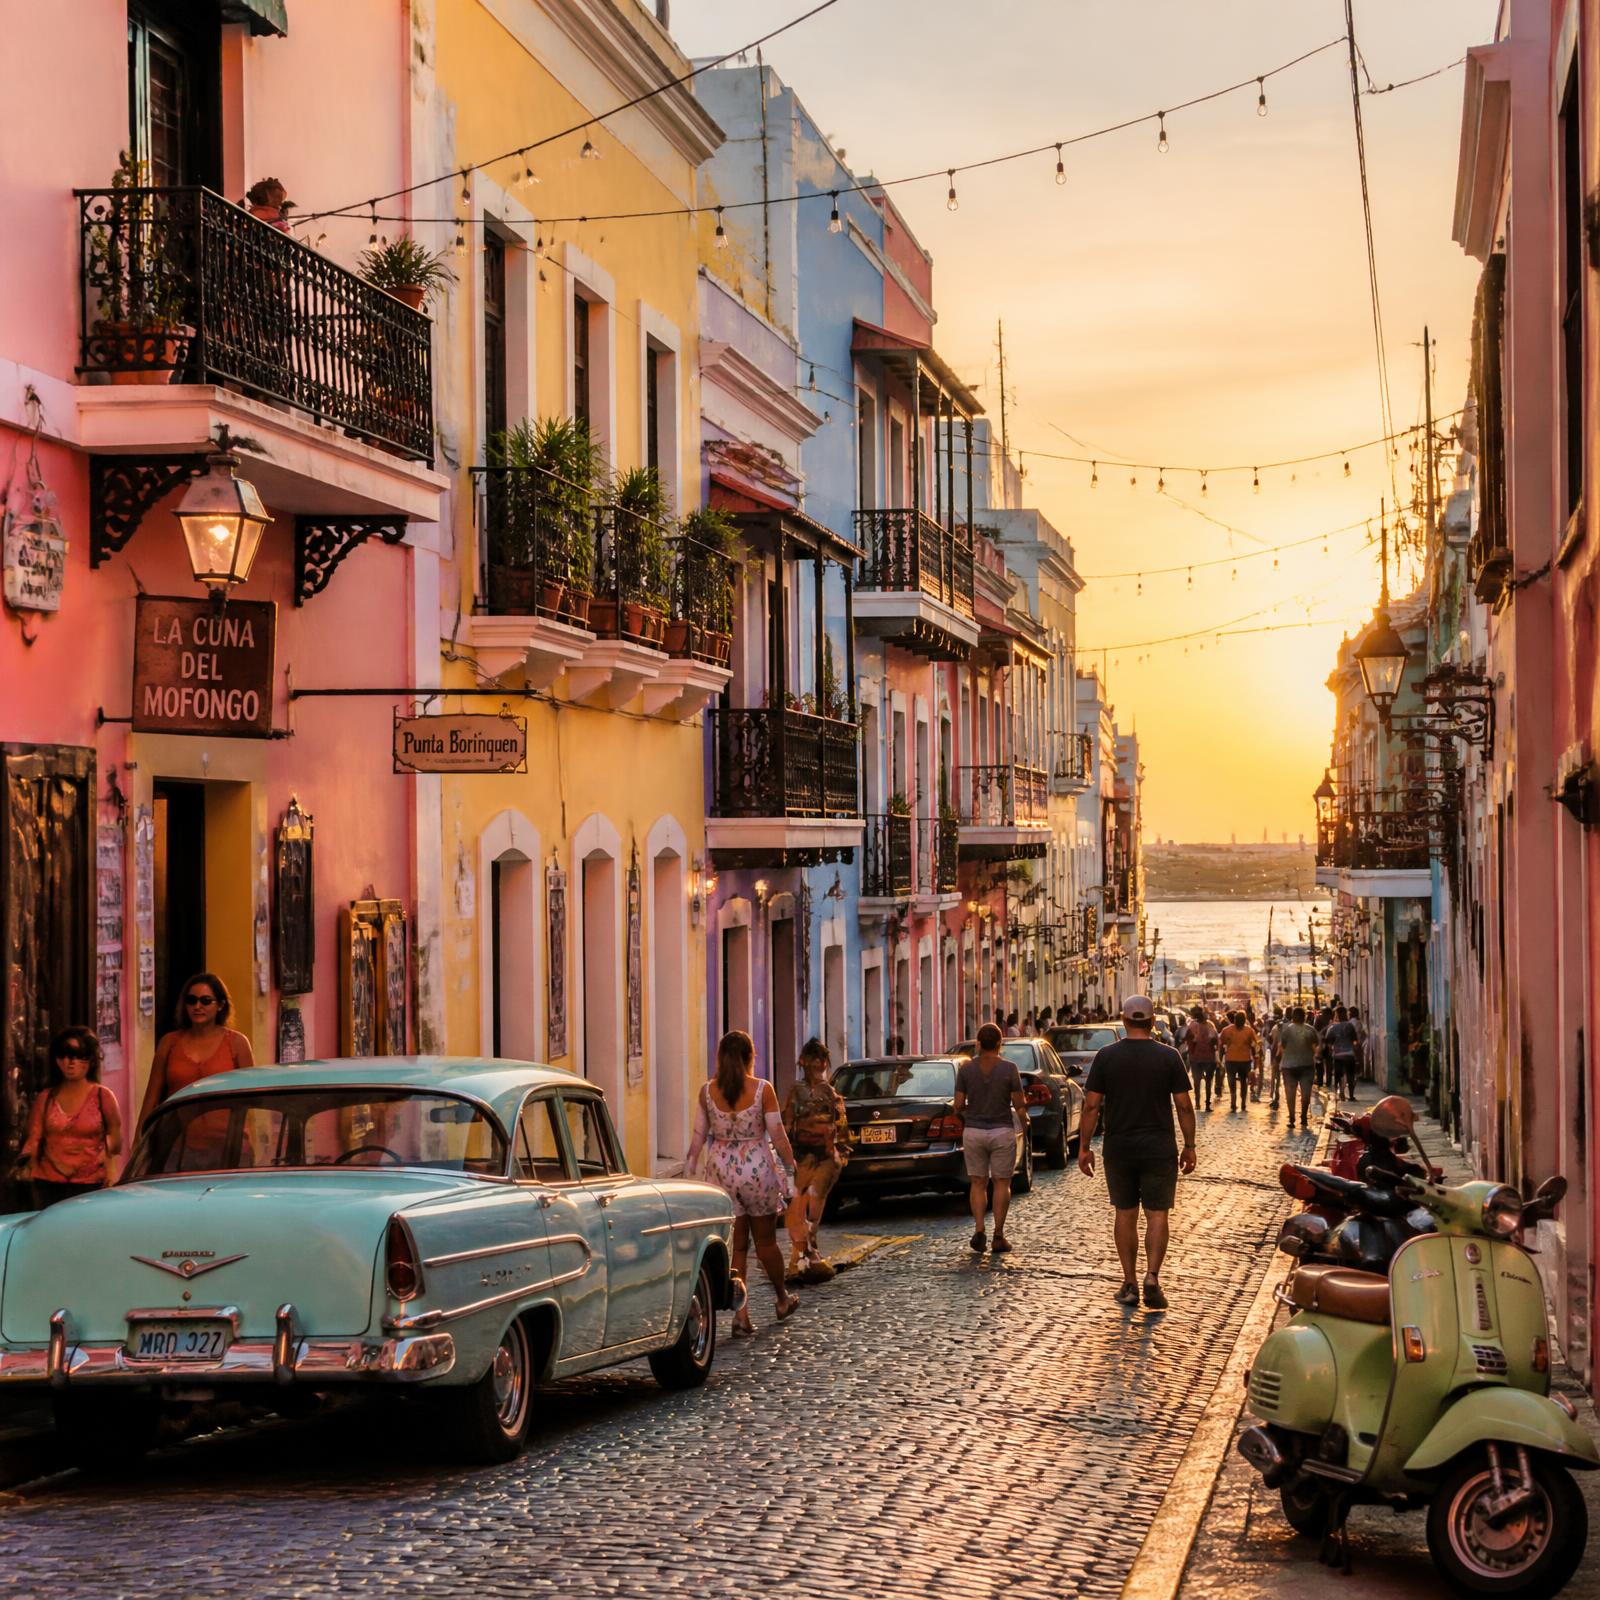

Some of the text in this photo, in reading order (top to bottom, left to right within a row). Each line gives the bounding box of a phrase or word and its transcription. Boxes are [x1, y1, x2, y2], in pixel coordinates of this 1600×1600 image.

[153, 617, 255, 648] LA CUNA
[181, 651, 223, 681] DEL
[143, 685, 260, 721] MOFONGO
[402, 731, 444, 754] Punta
